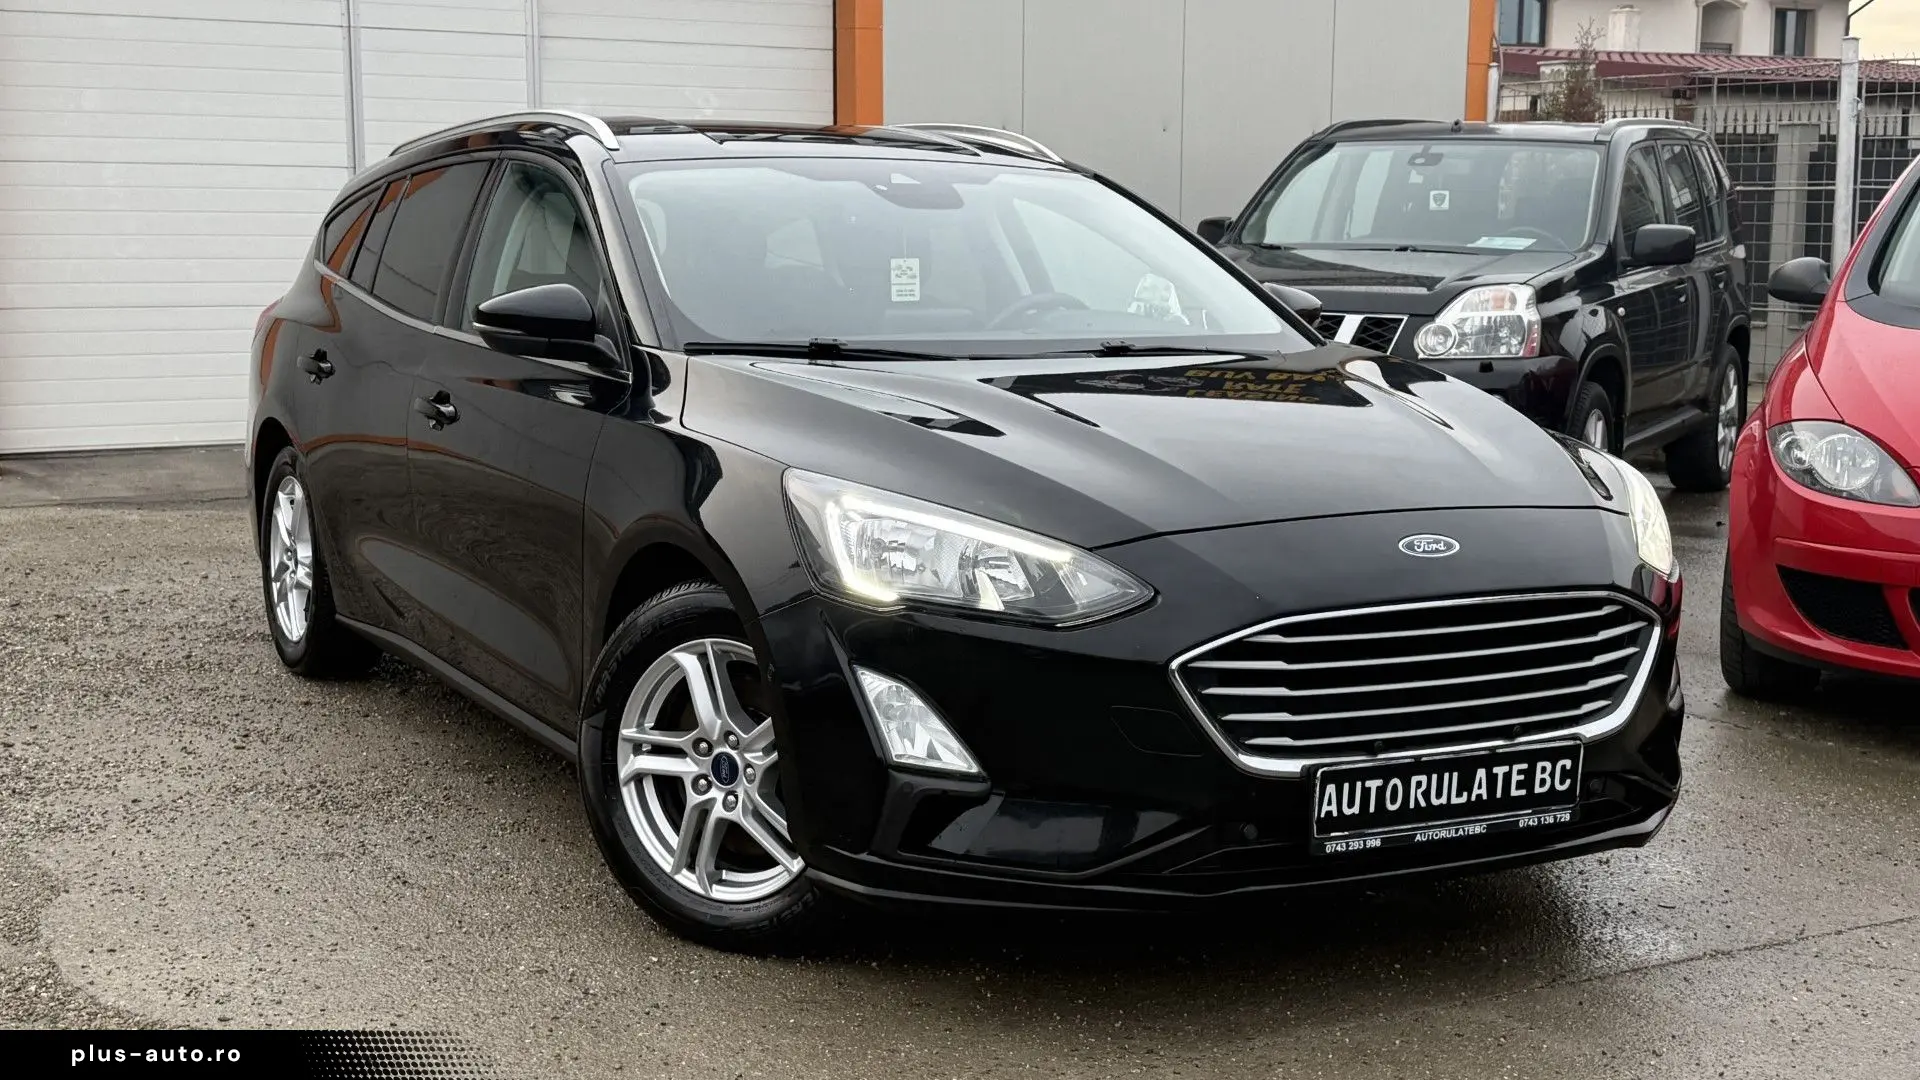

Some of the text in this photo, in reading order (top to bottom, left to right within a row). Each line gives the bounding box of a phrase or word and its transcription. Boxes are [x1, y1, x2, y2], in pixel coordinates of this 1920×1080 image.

[1413, 539, 1447, 552] Ford
[1320, 758, 1573, 818] AUTO RULATE BC
[1519, 812, 1571, 828] 0743 136 729
[1414, 824, 1488, 842] AUTORULATEBC
[1325, 842, 1347, 854] 0743
[1348, 840, 1364, 851] 293
